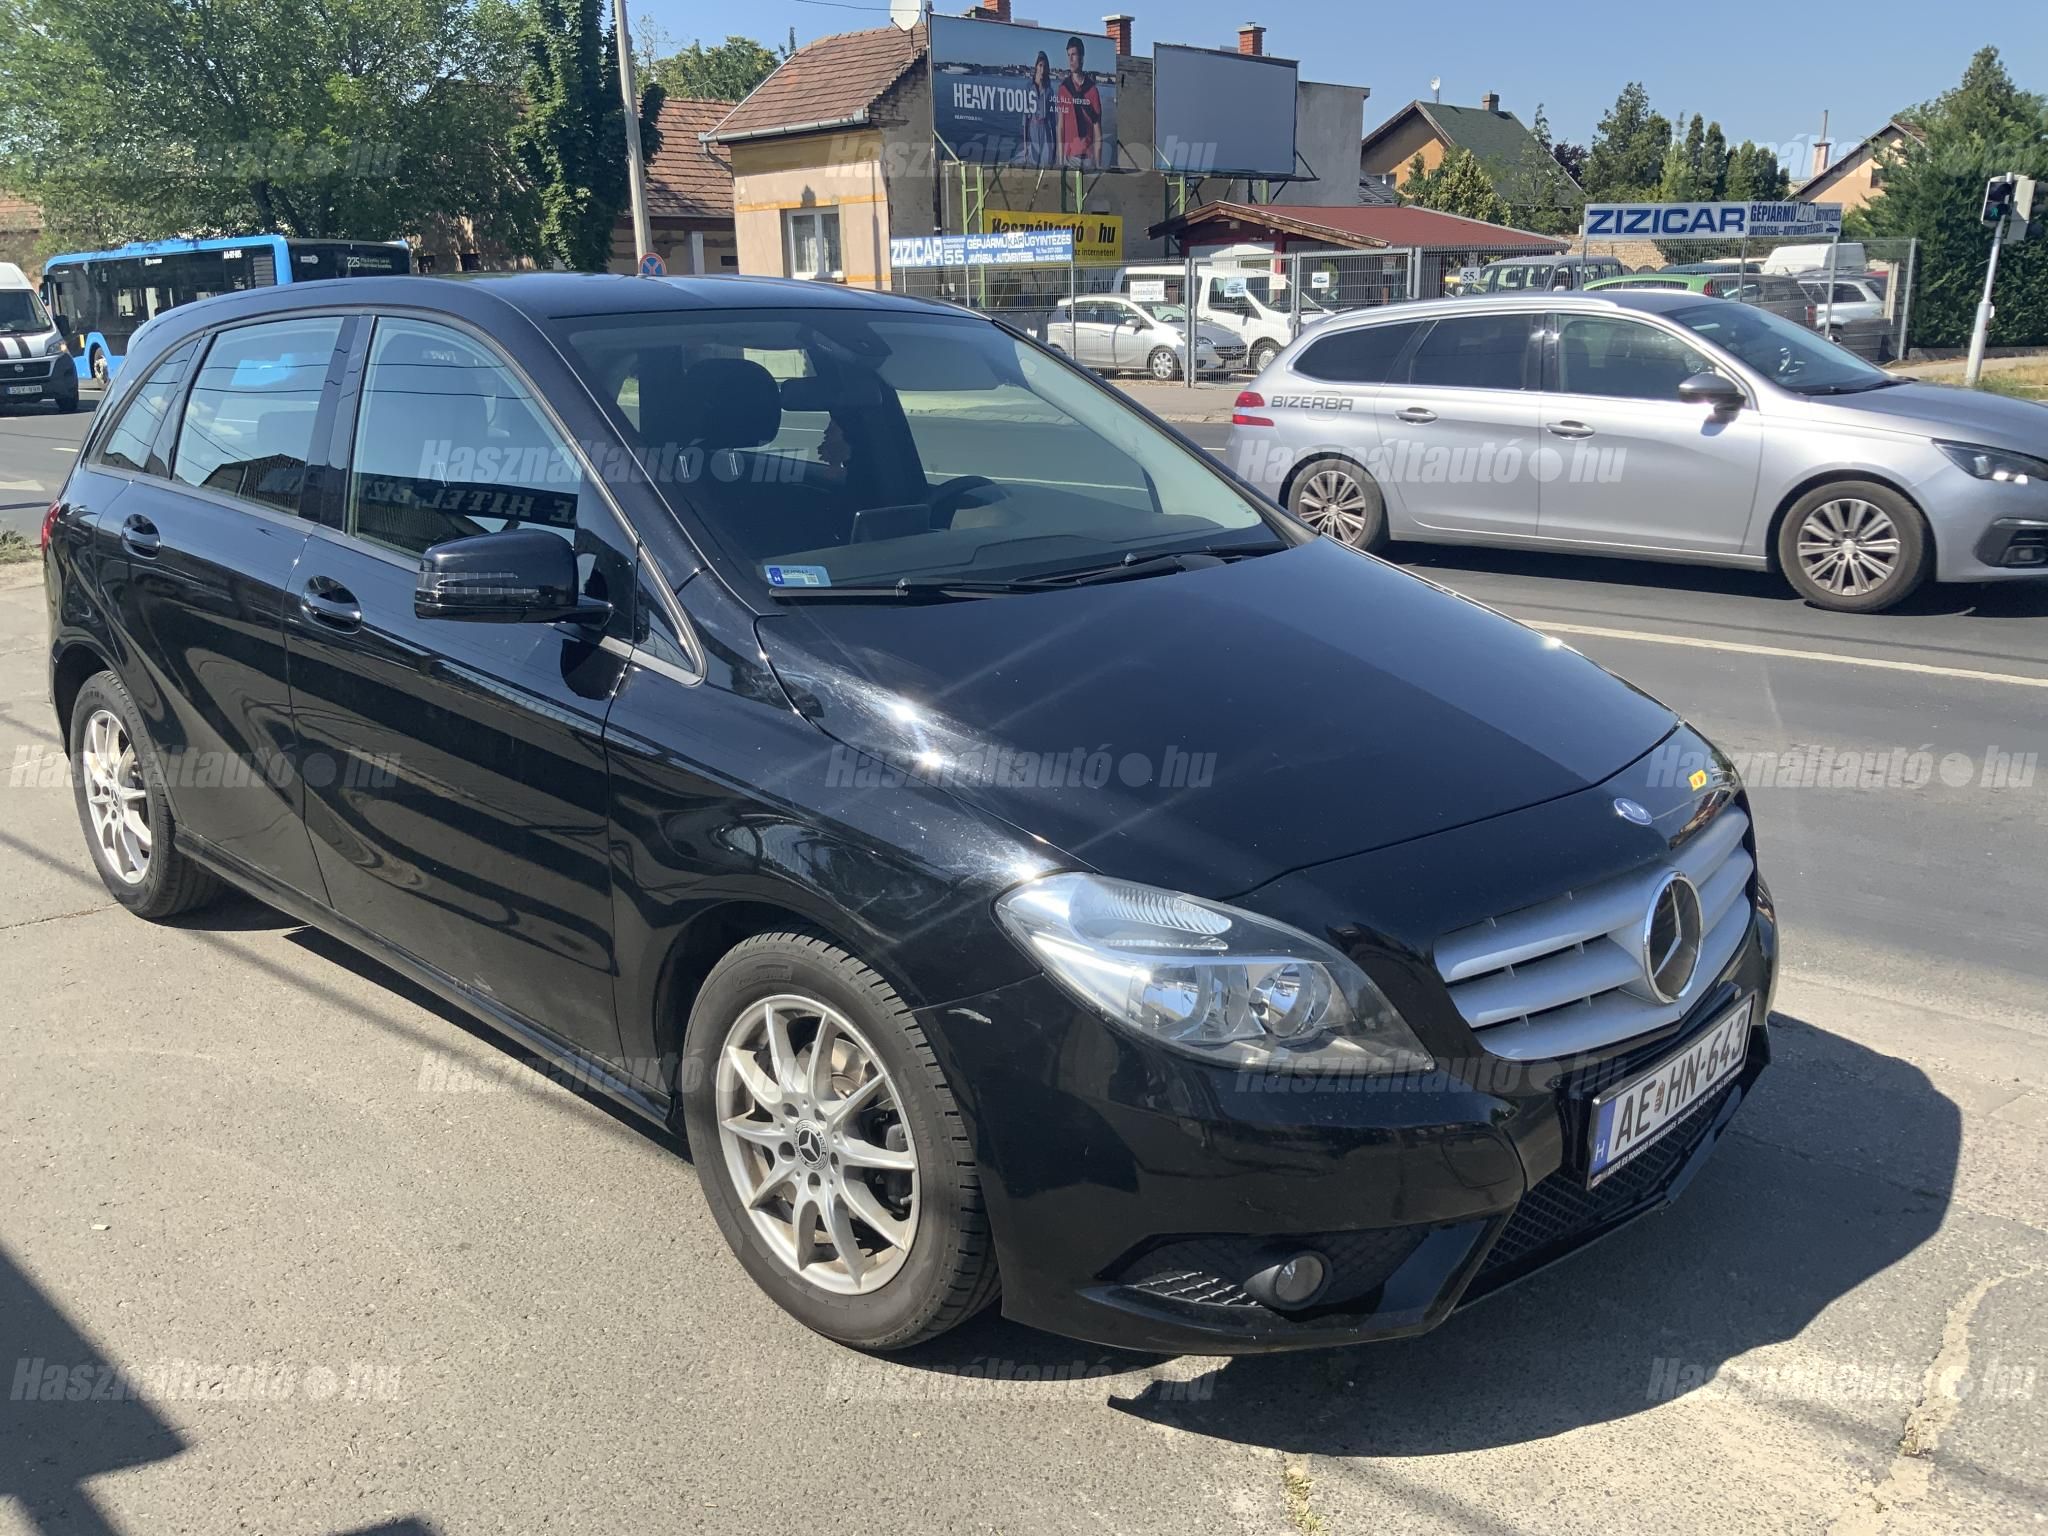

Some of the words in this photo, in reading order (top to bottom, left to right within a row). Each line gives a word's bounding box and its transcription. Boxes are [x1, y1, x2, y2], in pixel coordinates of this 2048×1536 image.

[953, 83, 996, 111] HEAVY
[996, 87, 1037, 113] TOOLS
[1587, 207, 1745, 234] ZIZICAR
[347, 257, 359, 267] 225
[891, 237, 943, 266] ZIZICAR
[1271, 395, 1354, 411] BIZERBA
[1615, 1080, 1656, 1150] AE
[1665, 1009, 1747, 1116] HN-643
[1595, 1139, 1605, 1162] H
